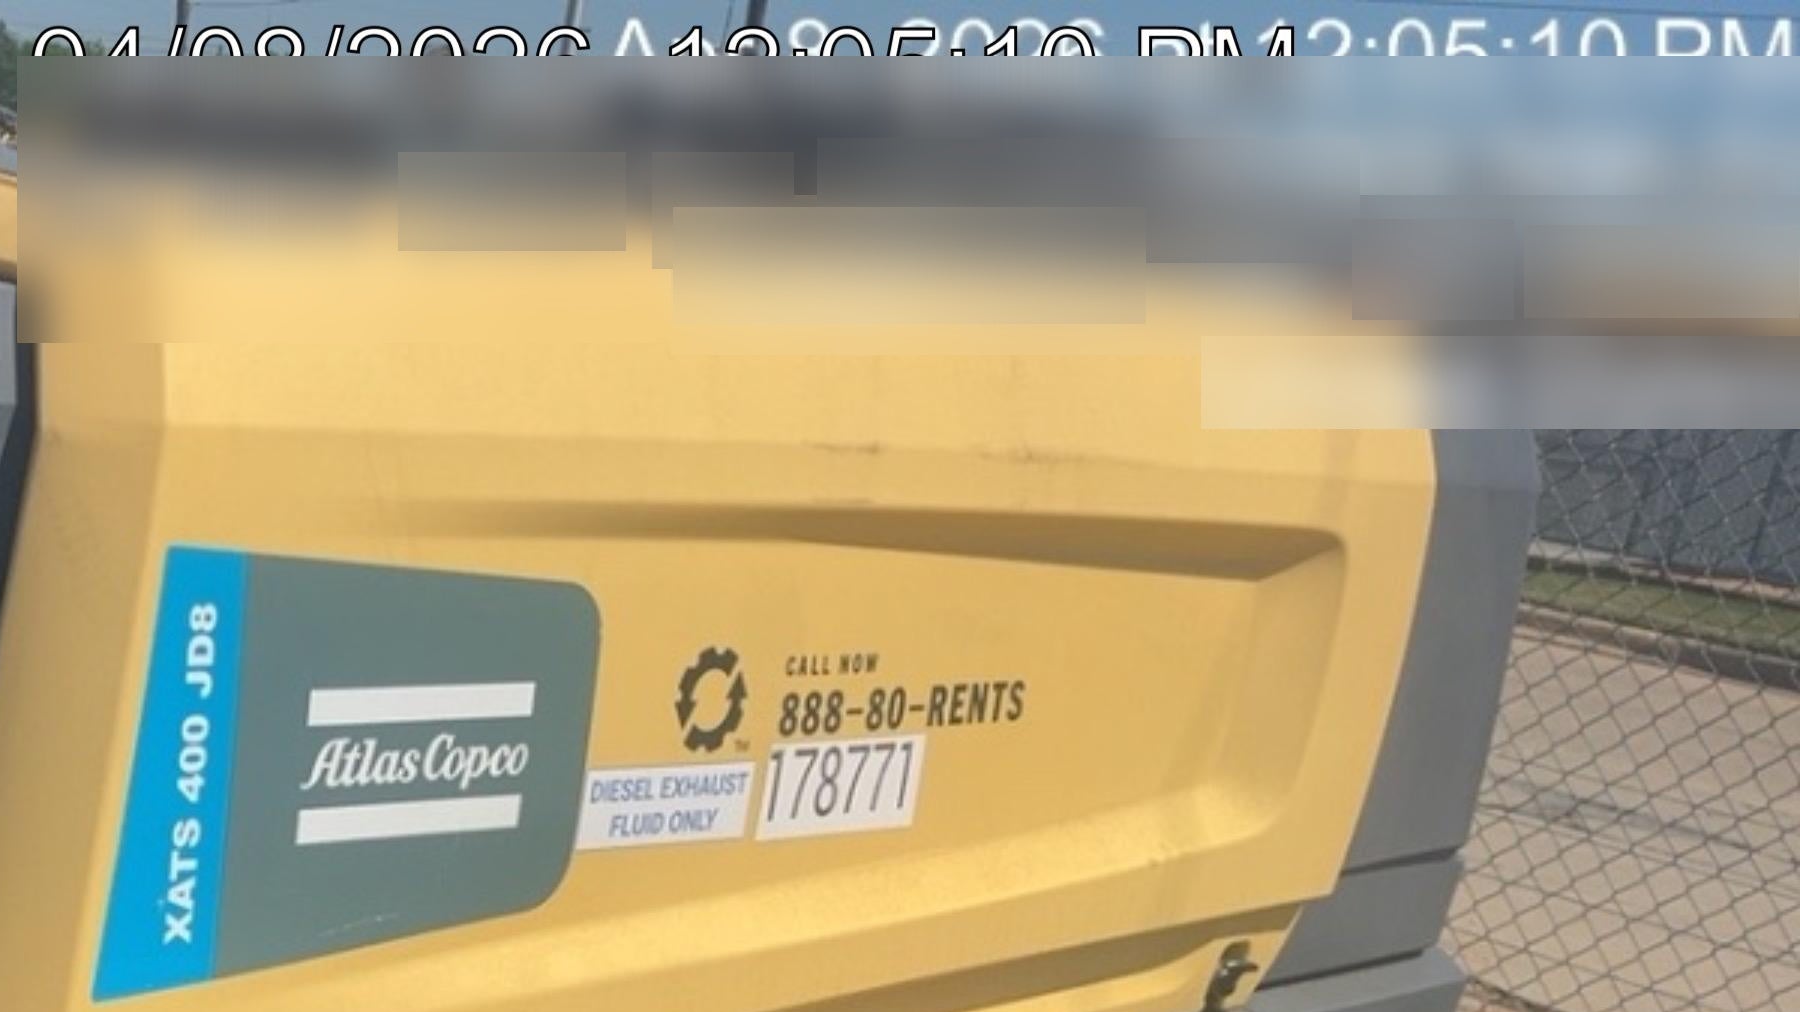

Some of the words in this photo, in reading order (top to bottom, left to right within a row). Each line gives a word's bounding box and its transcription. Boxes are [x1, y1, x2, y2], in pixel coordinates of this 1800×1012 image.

[185, 602, 218, 698] JD8
[785, 655, 831, 677] CALL
[838, 653, 880, 674] NOW
[779, 680, 1027, 737] 888-80-RENTS
[176, 714, 211, 802] 400
[590, 776, 655, 805] DIESEL
[660, 771, 750, 802] EXHAUST
[766, 741, 914, 823] 178771
[608, 812, 664, 840] FLUID
[668, 808, 719, 835] ONLY
[163, 818, 201, 946] XATS
